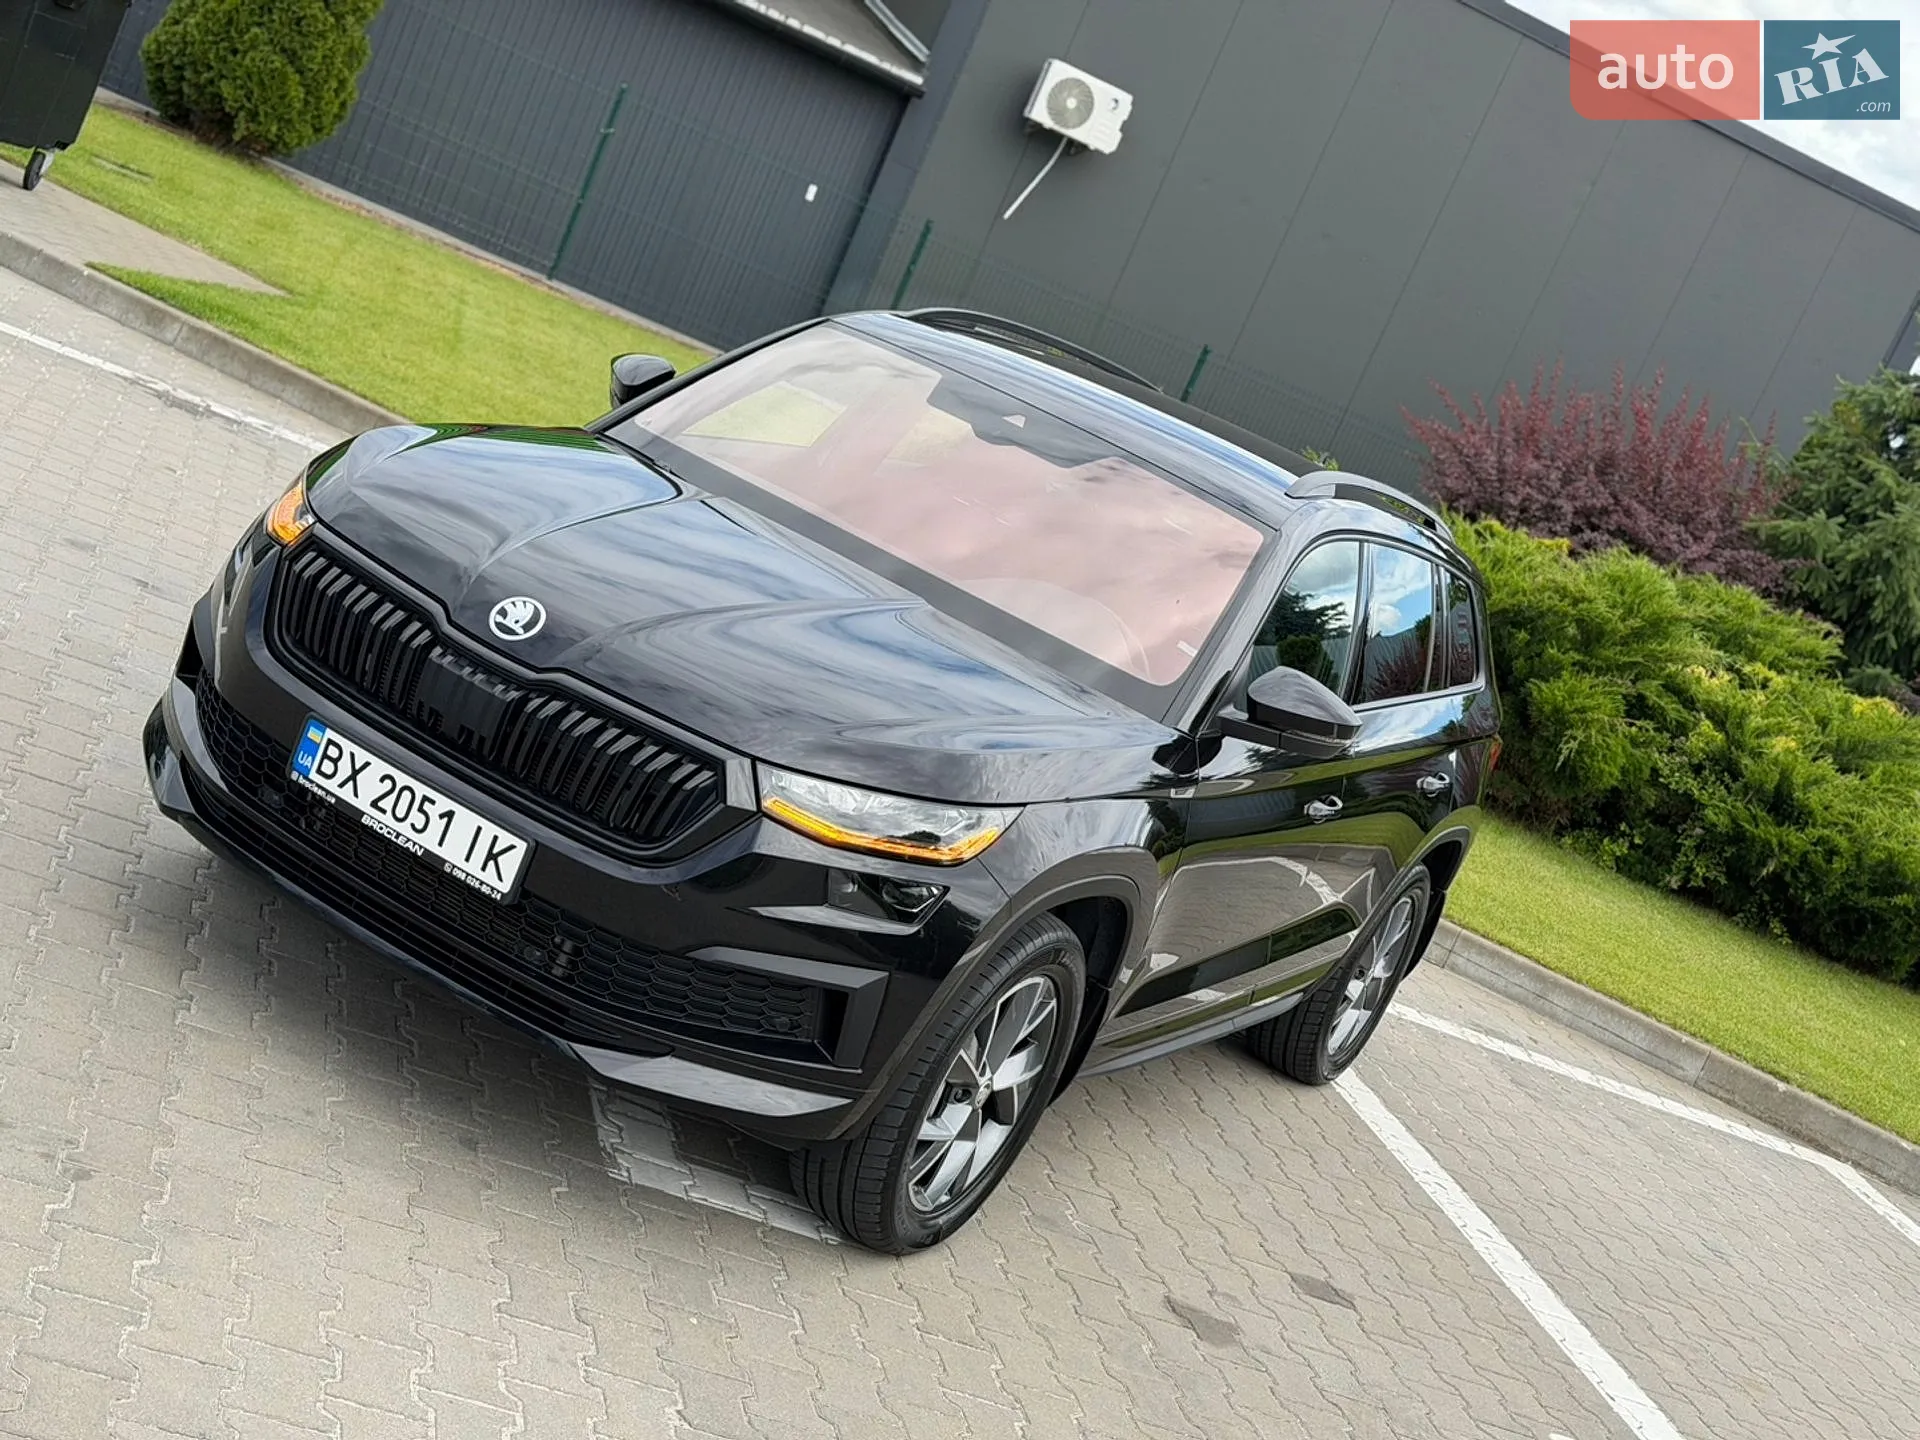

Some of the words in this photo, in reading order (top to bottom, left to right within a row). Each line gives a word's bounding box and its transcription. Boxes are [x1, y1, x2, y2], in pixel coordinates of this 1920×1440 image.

[298, 750, 313, 770] UA
[315, 738, 372, 799] BX
[369, 773, 456, 848] 2051
[464, 825, 517, 883] IK
[361, 814, 425, 856] BROCLEAN
